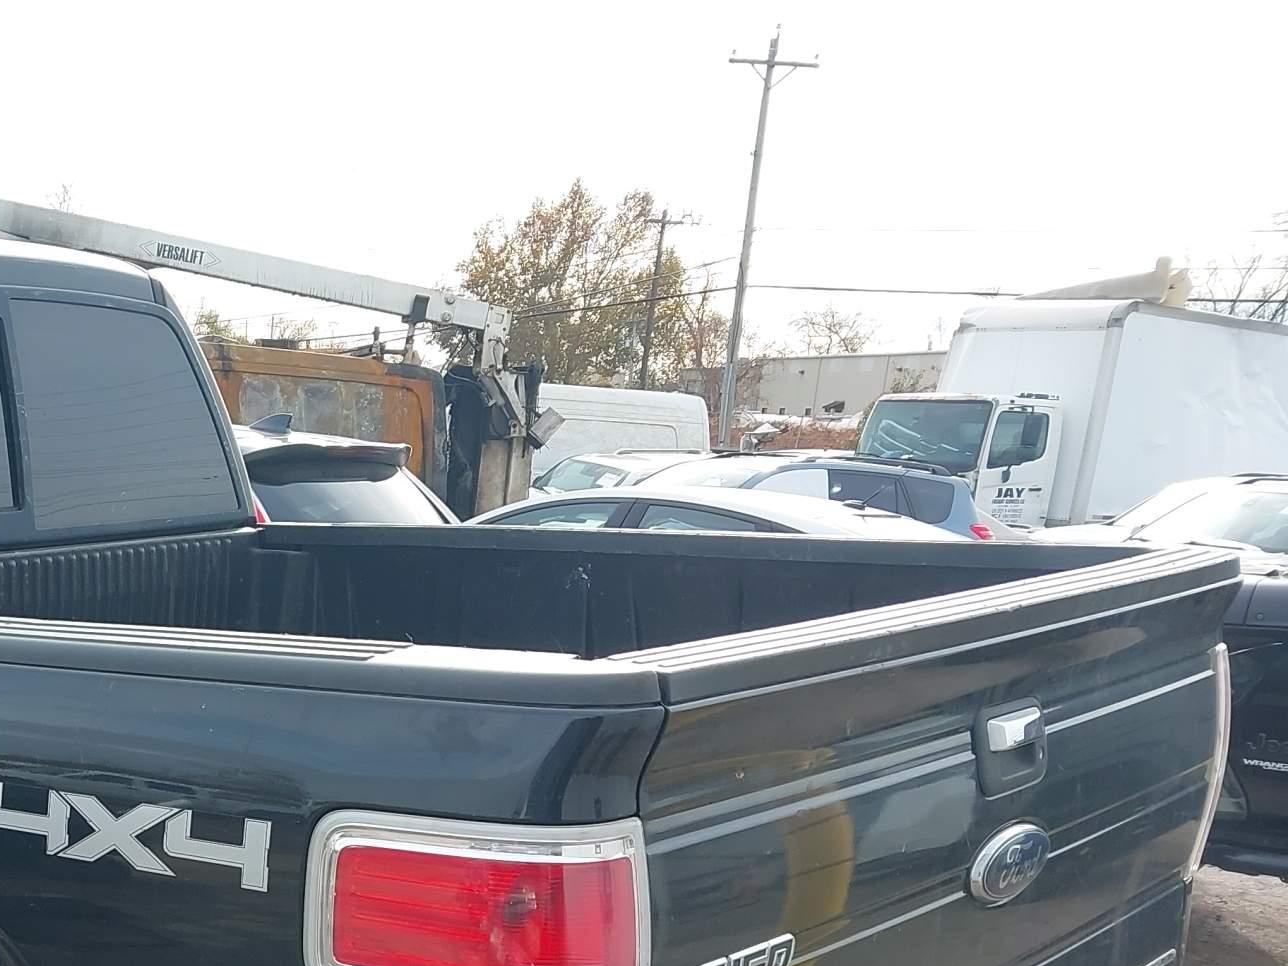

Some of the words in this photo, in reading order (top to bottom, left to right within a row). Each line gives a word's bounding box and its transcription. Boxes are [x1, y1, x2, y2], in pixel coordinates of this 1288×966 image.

[156, 242, 205, 265] VERSALIFT
[994, 487, 1027, 499] JAY
[998, 838, 1044, 890] Ford
